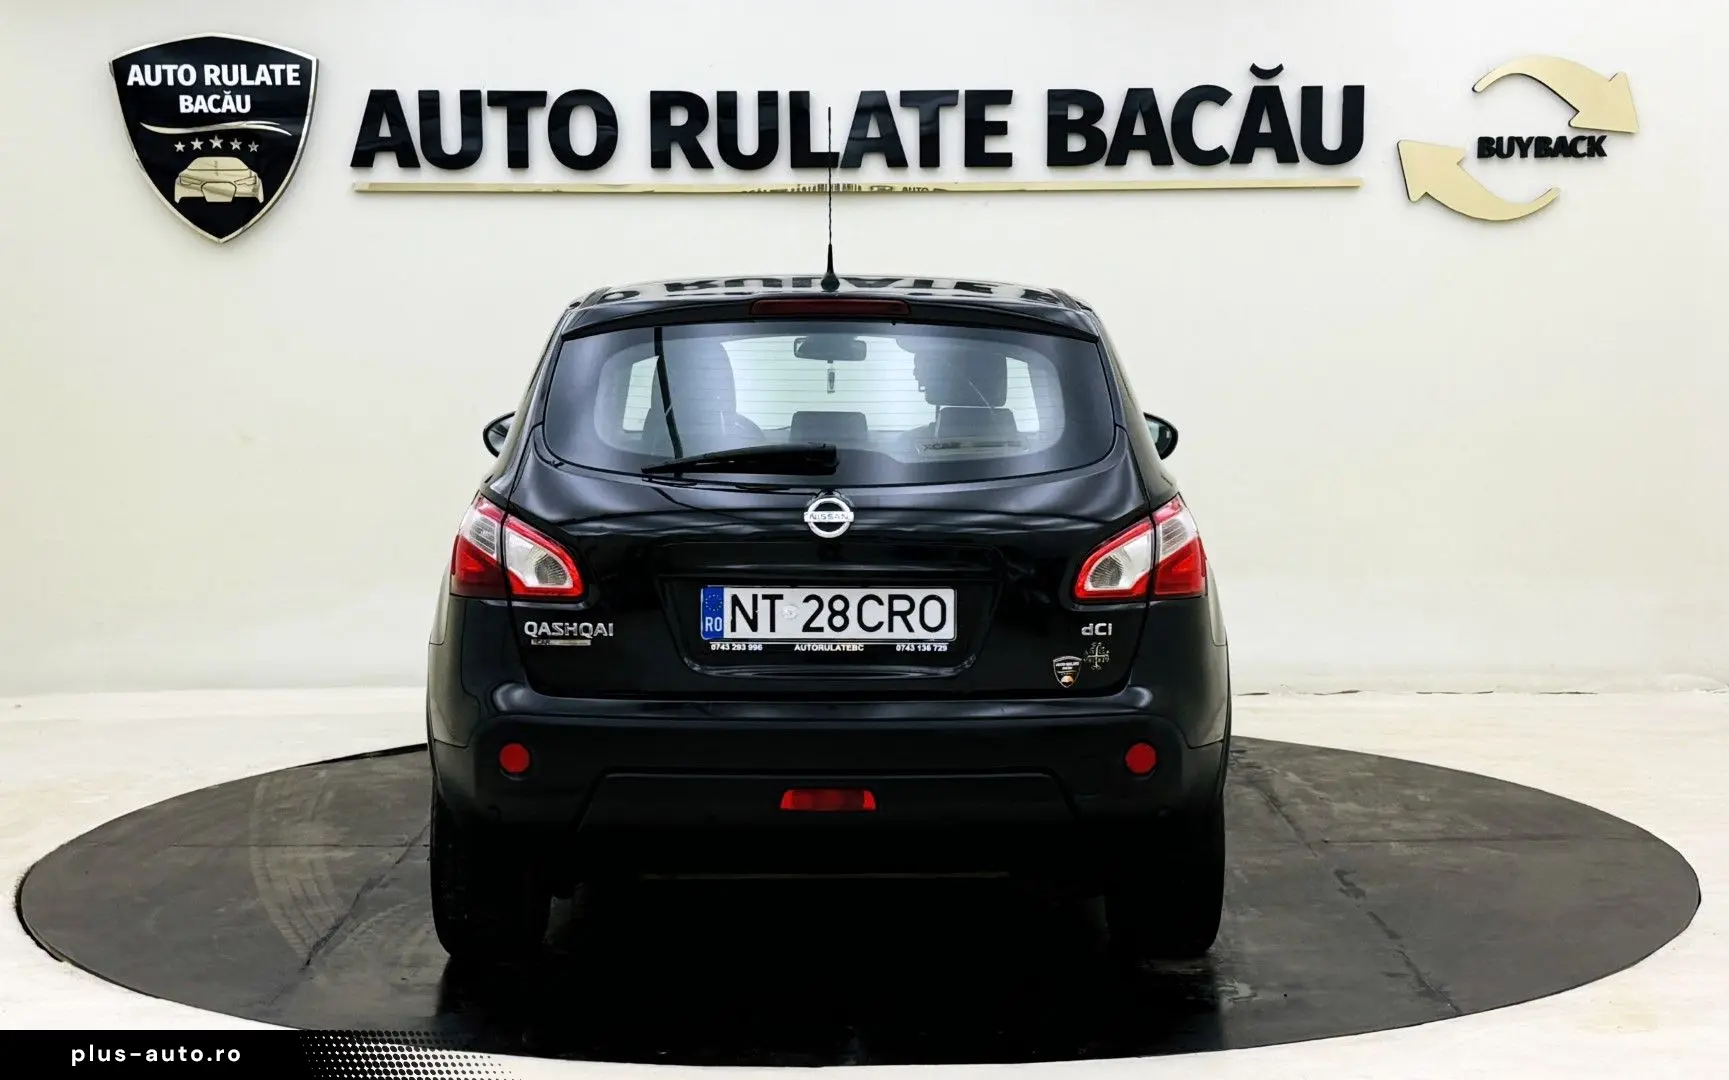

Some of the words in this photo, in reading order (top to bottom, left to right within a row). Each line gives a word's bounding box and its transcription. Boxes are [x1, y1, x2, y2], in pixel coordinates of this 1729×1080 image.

[126, 63, 197, 87] AUTO
[203, 63, 301, 87] RULATE
[178, 90, 251, 114] BACĂU
[350, 88, 619, 172] AUTO
[649, 89, 1014, 170] RULATE
[1046, 62, 1366, 167] BACĂU
[1476, 135, 1608, 159] BUYBACK
[705, 616, 723, 632] RO
[730, 593, 784, 633] NT
[523, 621, 614, 639] QASHQAI
[794, 643, 865, 652] AUTORULATEBC
